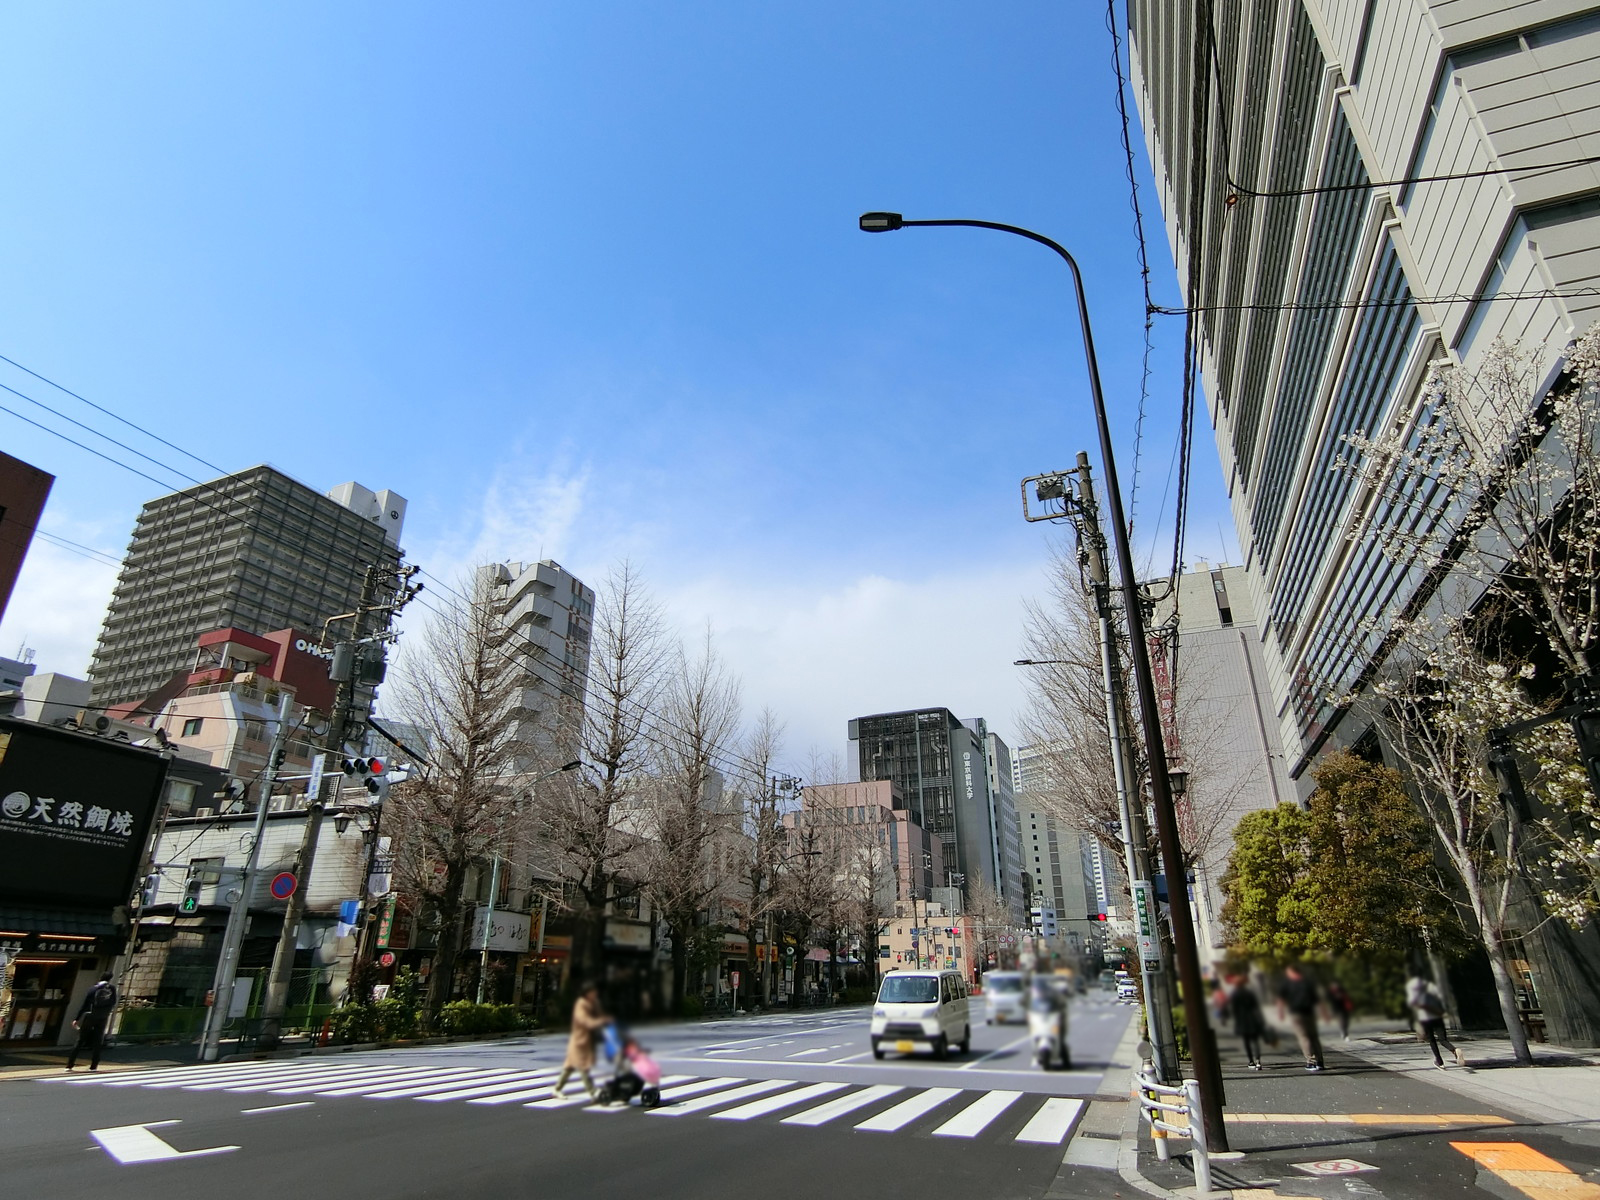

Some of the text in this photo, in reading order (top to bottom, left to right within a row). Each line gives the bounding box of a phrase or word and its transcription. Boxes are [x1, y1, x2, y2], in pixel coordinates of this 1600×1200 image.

[964, 761, 974, 799] 東京歯科大学
[28, 796, 134, 836] 天然鯛焼
